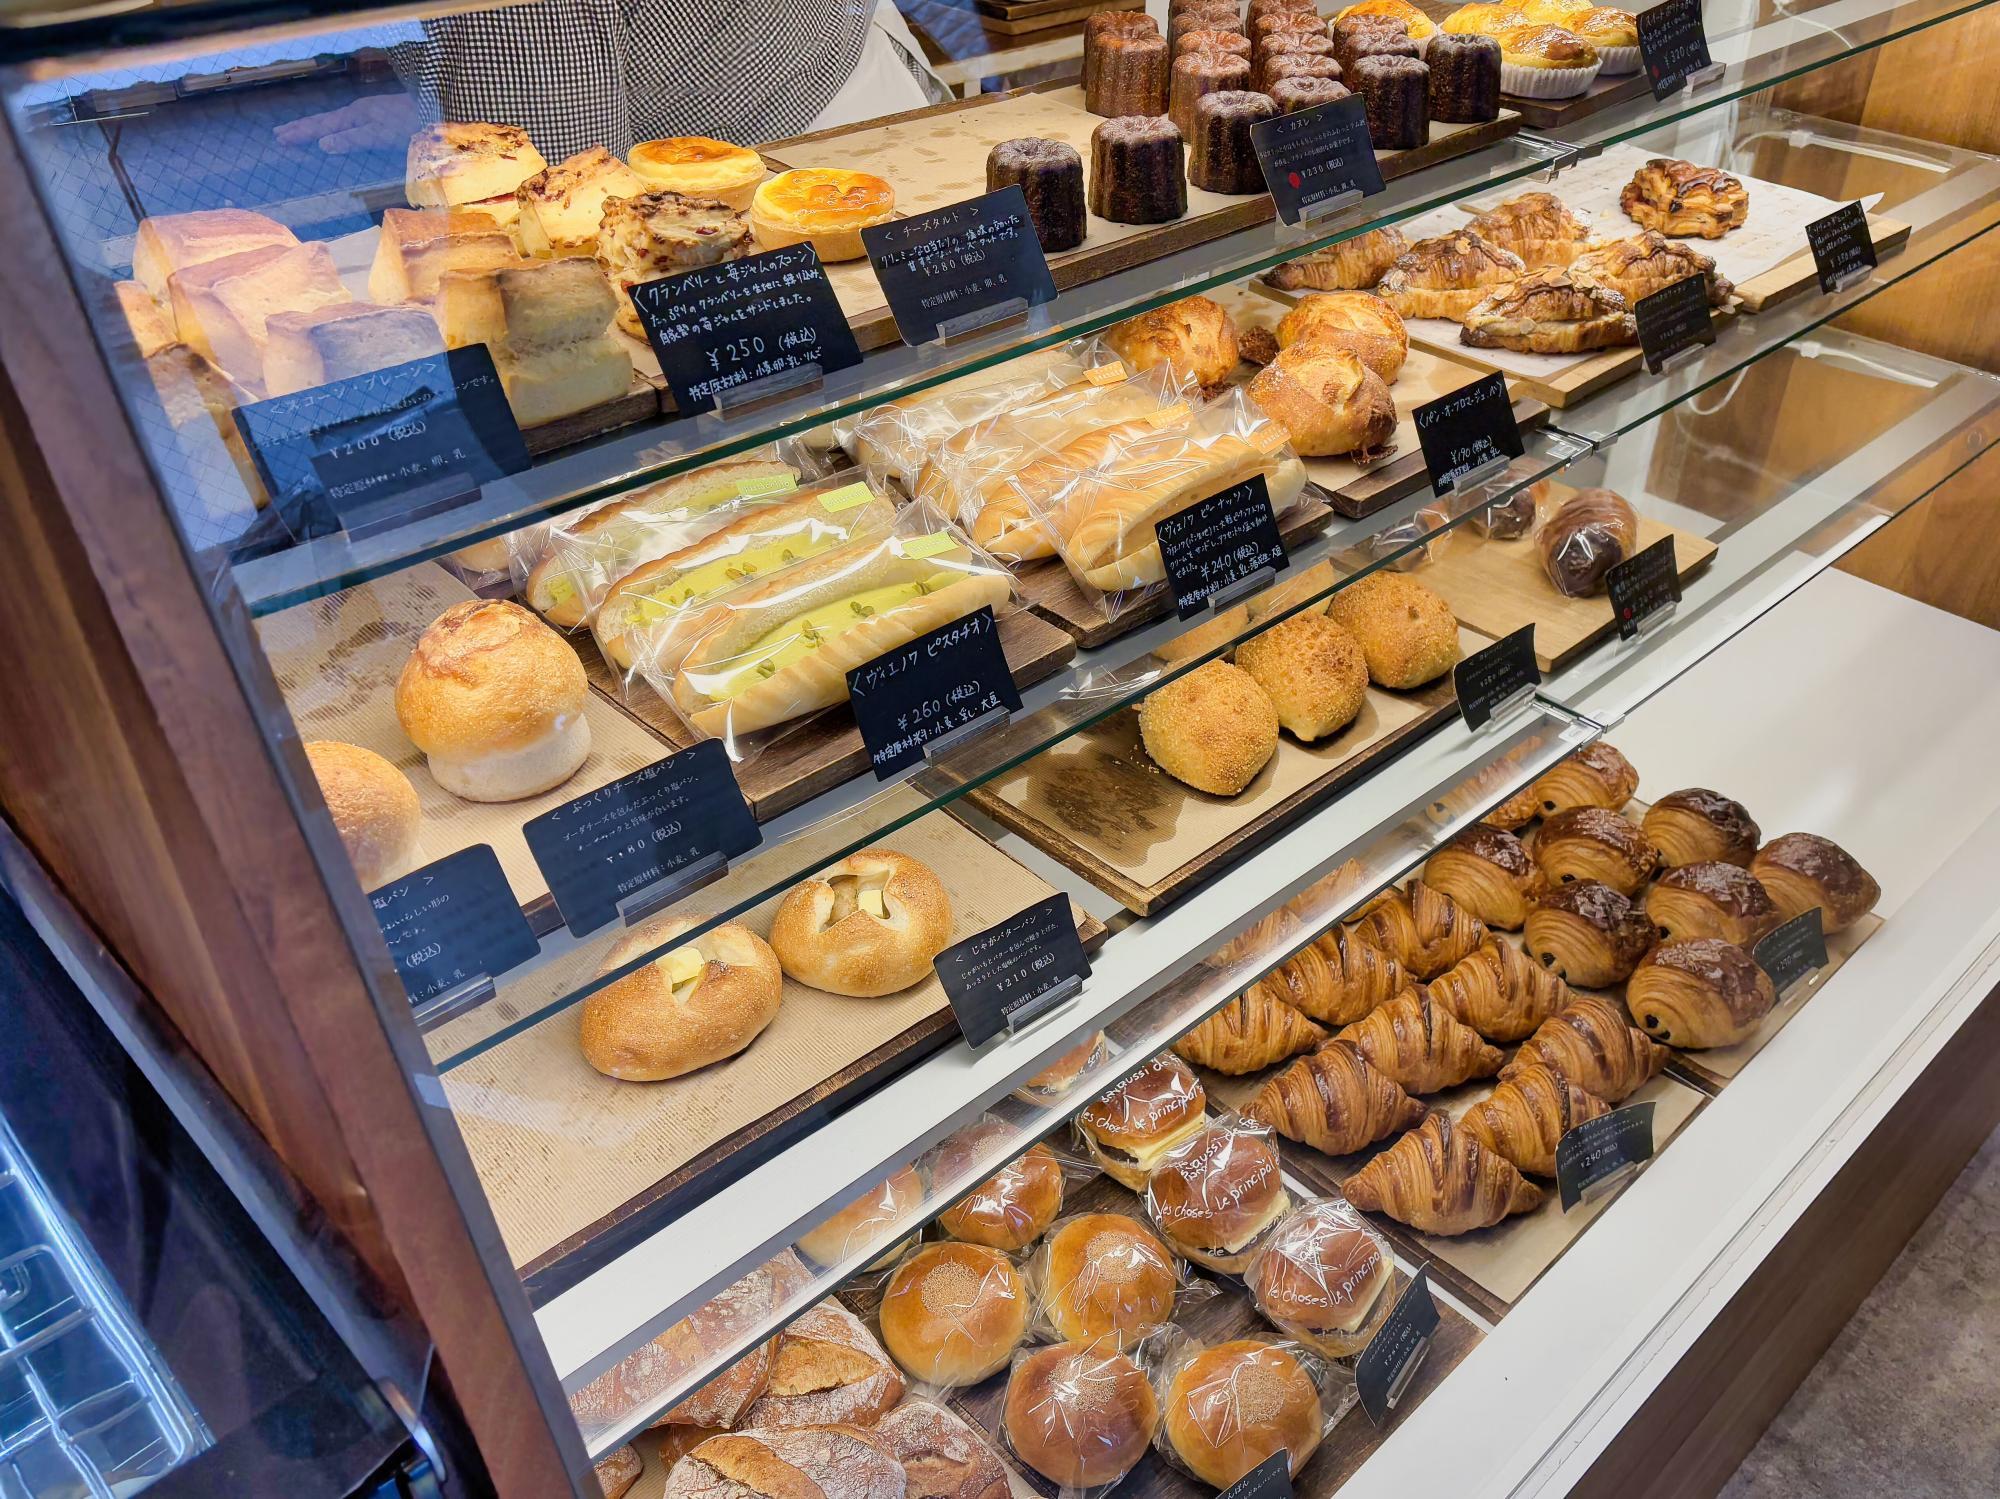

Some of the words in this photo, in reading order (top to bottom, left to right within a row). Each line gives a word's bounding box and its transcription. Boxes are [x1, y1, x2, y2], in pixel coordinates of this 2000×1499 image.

[903, 210, 960, 238] チーズタルト
[924, 260, 957, 277] ¥280
[1200, 555, 1232, 582] ¥240
[897, 700, 941, 731] ¥260
[651, 820, 682, 844] (税込)
[406, 942, 441, 968] (税込)
[996, 968, 1027, 992] ¥210
[1031, 952, 1055, 972] (税込)
